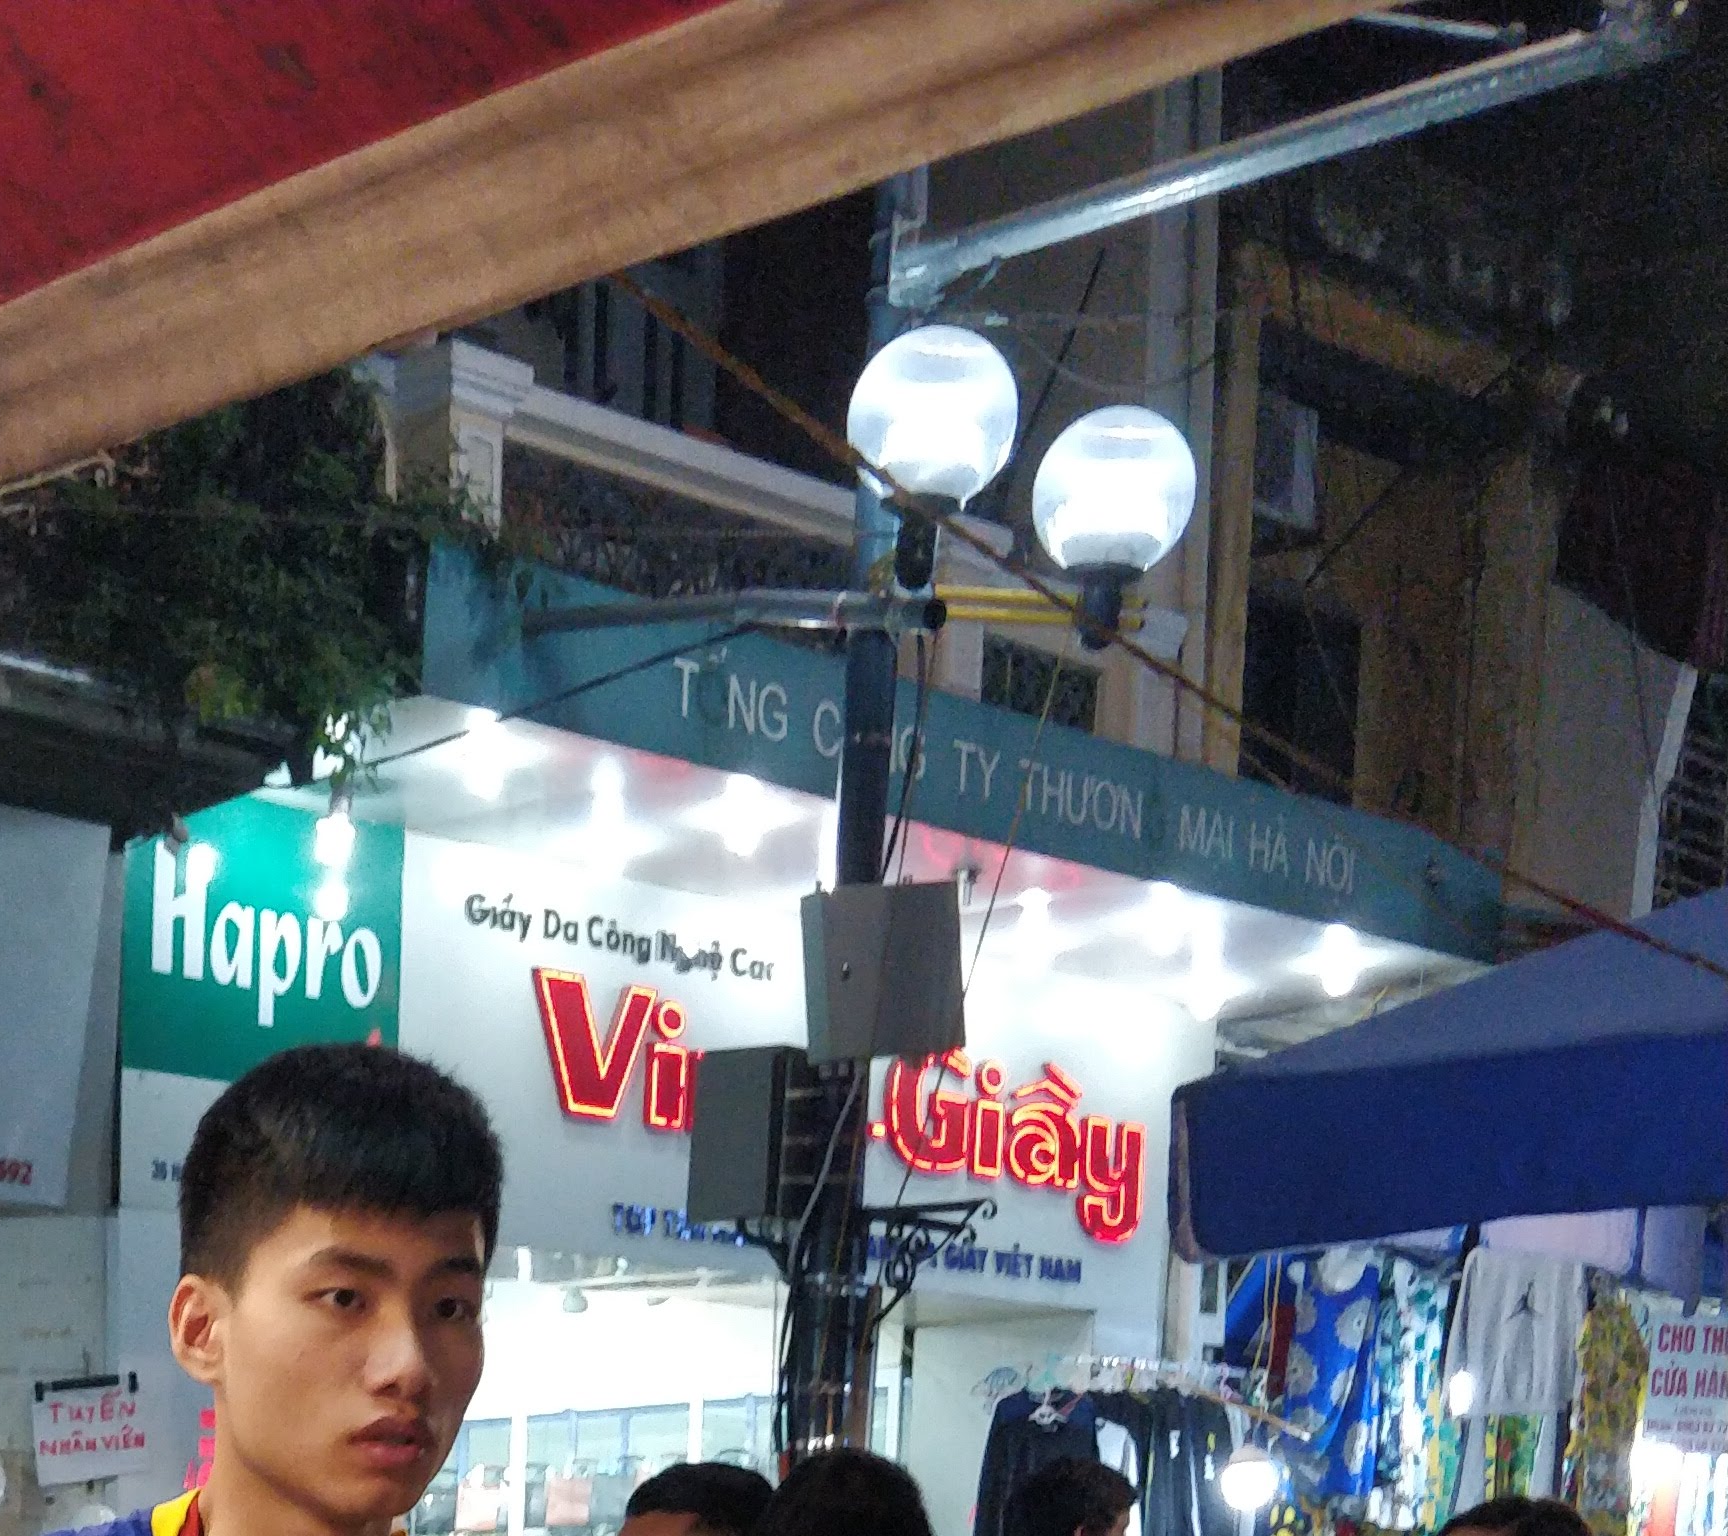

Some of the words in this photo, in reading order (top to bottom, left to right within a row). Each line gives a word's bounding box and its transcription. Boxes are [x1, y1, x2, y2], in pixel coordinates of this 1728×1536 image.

[673, 645, 788, 742] TNG
[953, 739, 1000, 799] TY
[151, 840, 382, 1027] Hapro
[543, 909, 578, 944] Da
[1658, 1323, 1697, 1354] CHO
